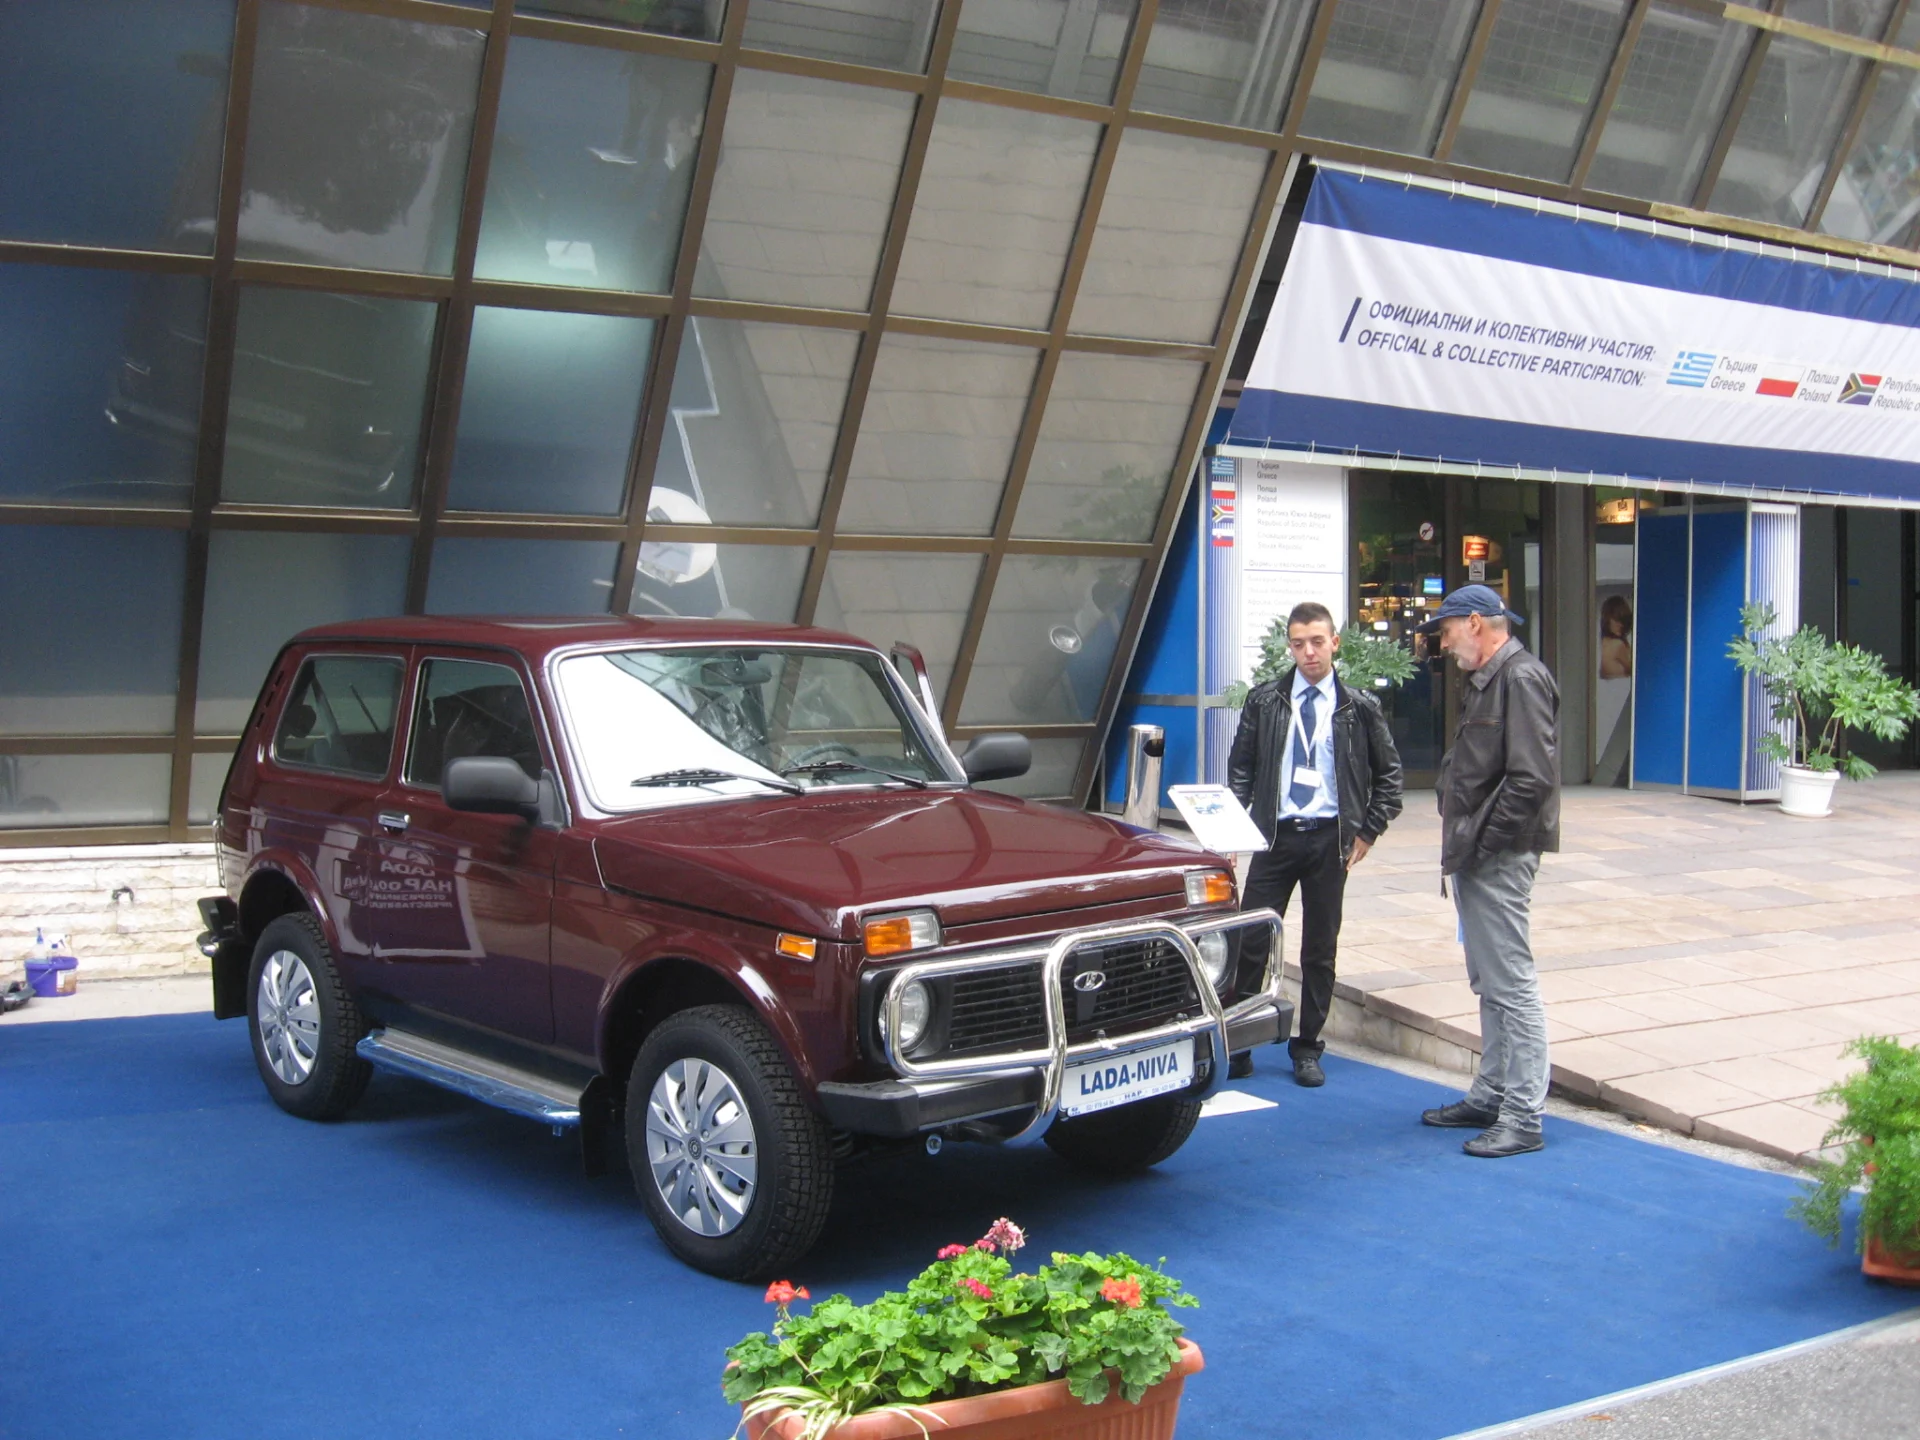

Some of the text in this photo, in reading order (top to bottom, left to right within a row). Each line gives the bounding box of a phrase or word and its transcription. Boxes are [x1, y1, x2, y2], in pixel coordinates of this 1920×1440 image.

[1369, 300, 1657, 362] ОФИЦИАЛНИ И КОЛЕКТИВНИ УЧАСТИЯ:
[1357, 329, 1647, 387] OFFICIAL & COLLECTIVE PARTICIPATION:
[1718, 356, 1758, 374] Гърция
[1710, 375, 1746, 392] Greece
[1806, 369, 1840, 385] Полша
[1797, 388, 1832, 404] Poland
[1874, 394, 1913, 411] Republic
[1256, 471, 1278, 480] Greece
[1256, 494, 1277, 503] Poland
[1080, 1052, 1178, 1095] LADA-NIVA
